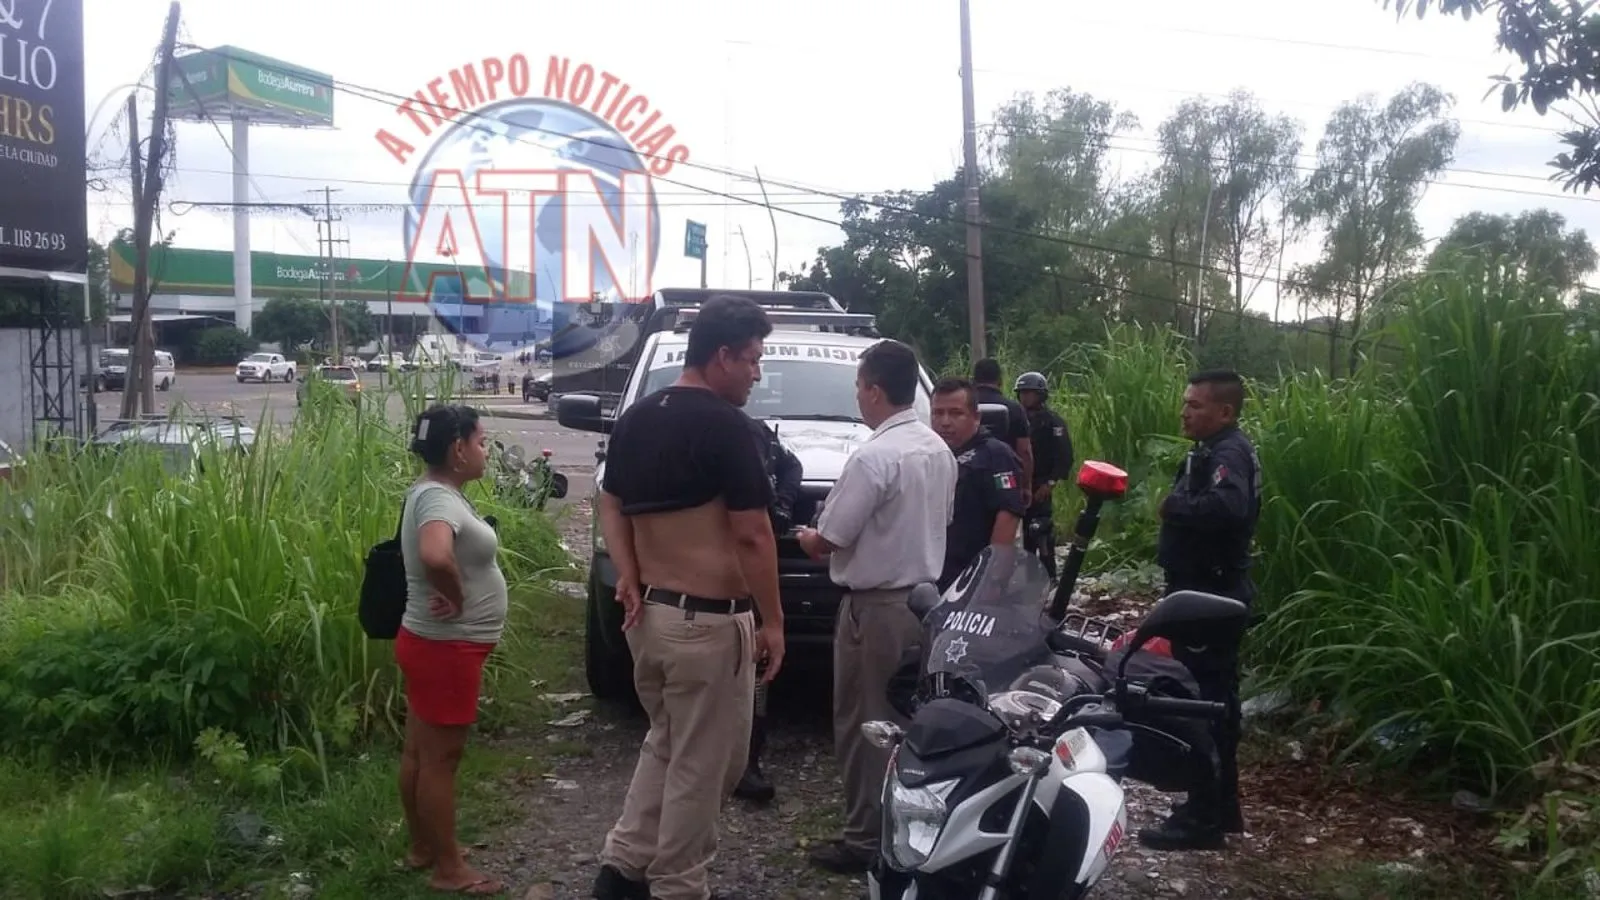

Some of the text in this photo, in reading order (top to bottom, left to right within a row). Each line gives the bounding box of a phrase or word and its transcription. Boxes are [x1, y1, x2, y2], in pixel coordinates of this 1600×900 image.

[0, 33, 57, 90] LIO
[19, 149, 58, 168] CIUDAD
[13, 228, 32, 249] 118
[34, 231, 50, 250] 26
[51, 232, 66, 251] 93
[942, 611, 996, 637] POLICIA
